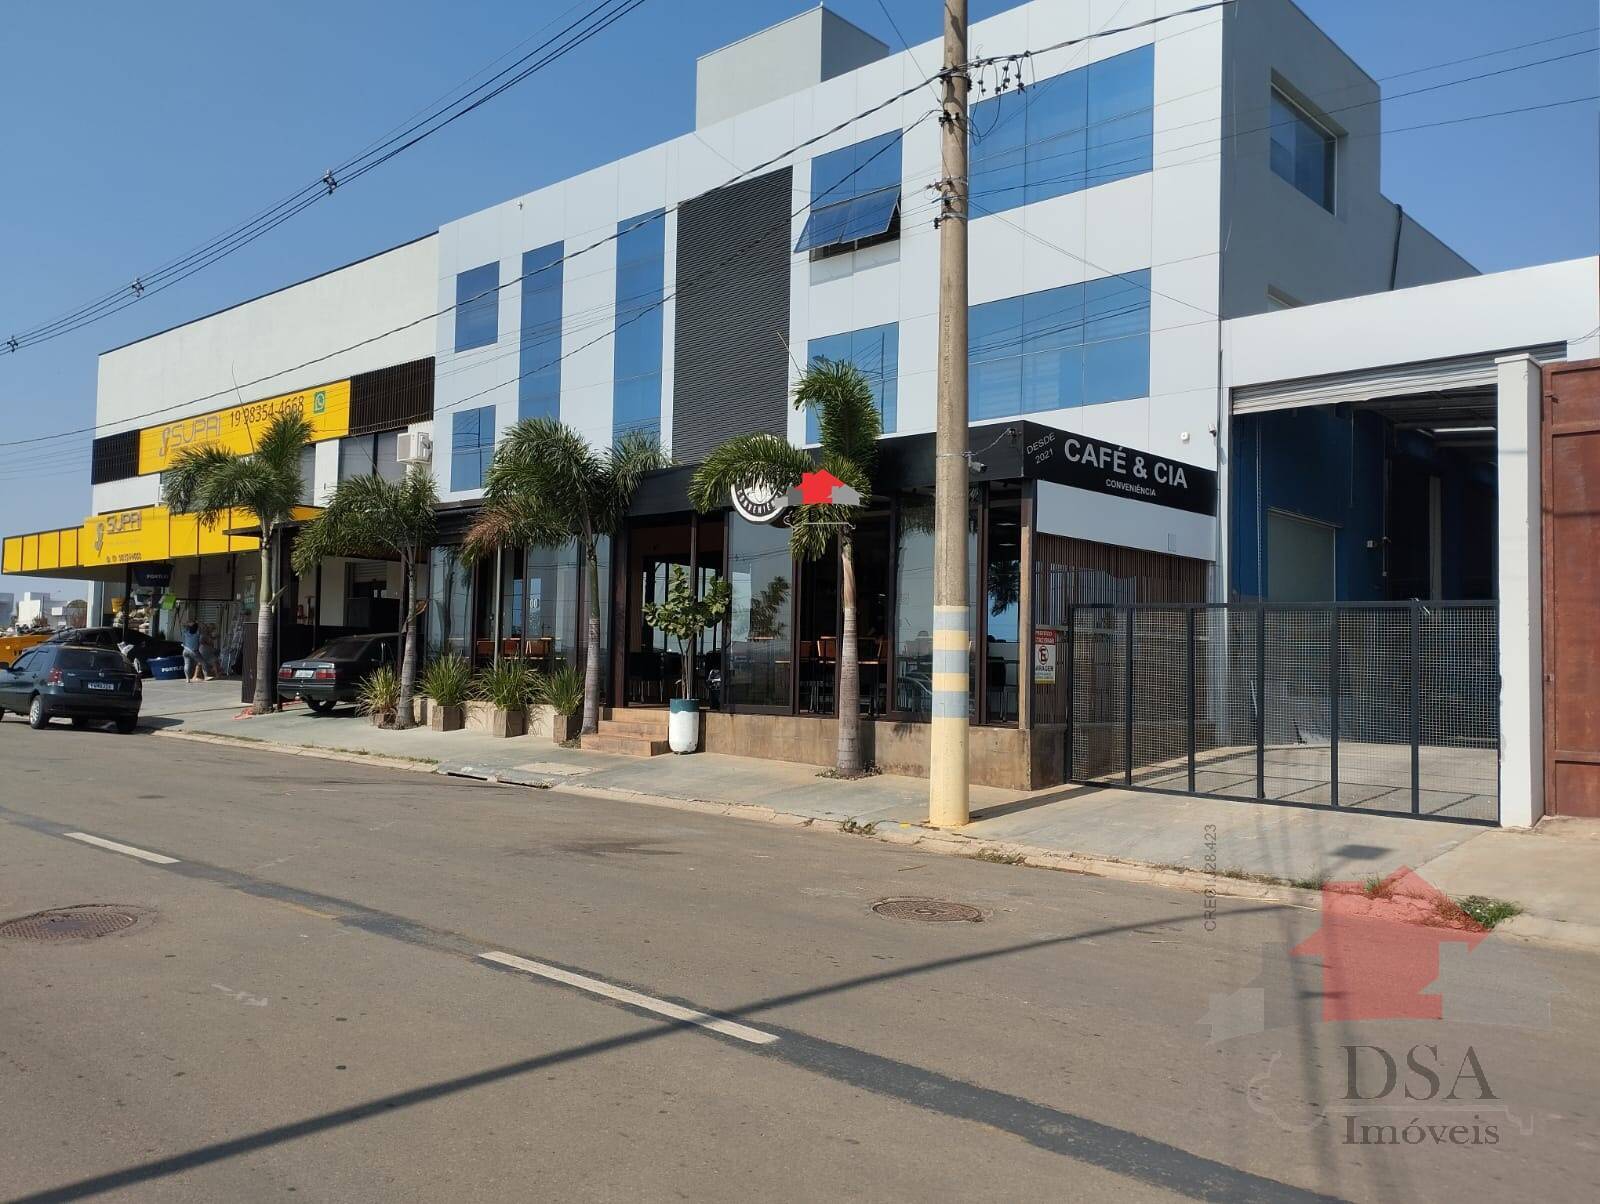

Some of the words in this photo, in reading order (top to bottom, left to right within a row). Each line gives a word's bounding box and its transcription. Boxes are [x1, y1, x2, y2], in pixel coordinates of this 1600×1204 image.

[1026, 432, 1056, 455] DESDE
[1035, 447, 1053, 464] 2021
[1064, 439, 1127, 474] CAFÉ
[1132, 456, 1149, 479] &
[1154, 462, 1188, 489] CIA
